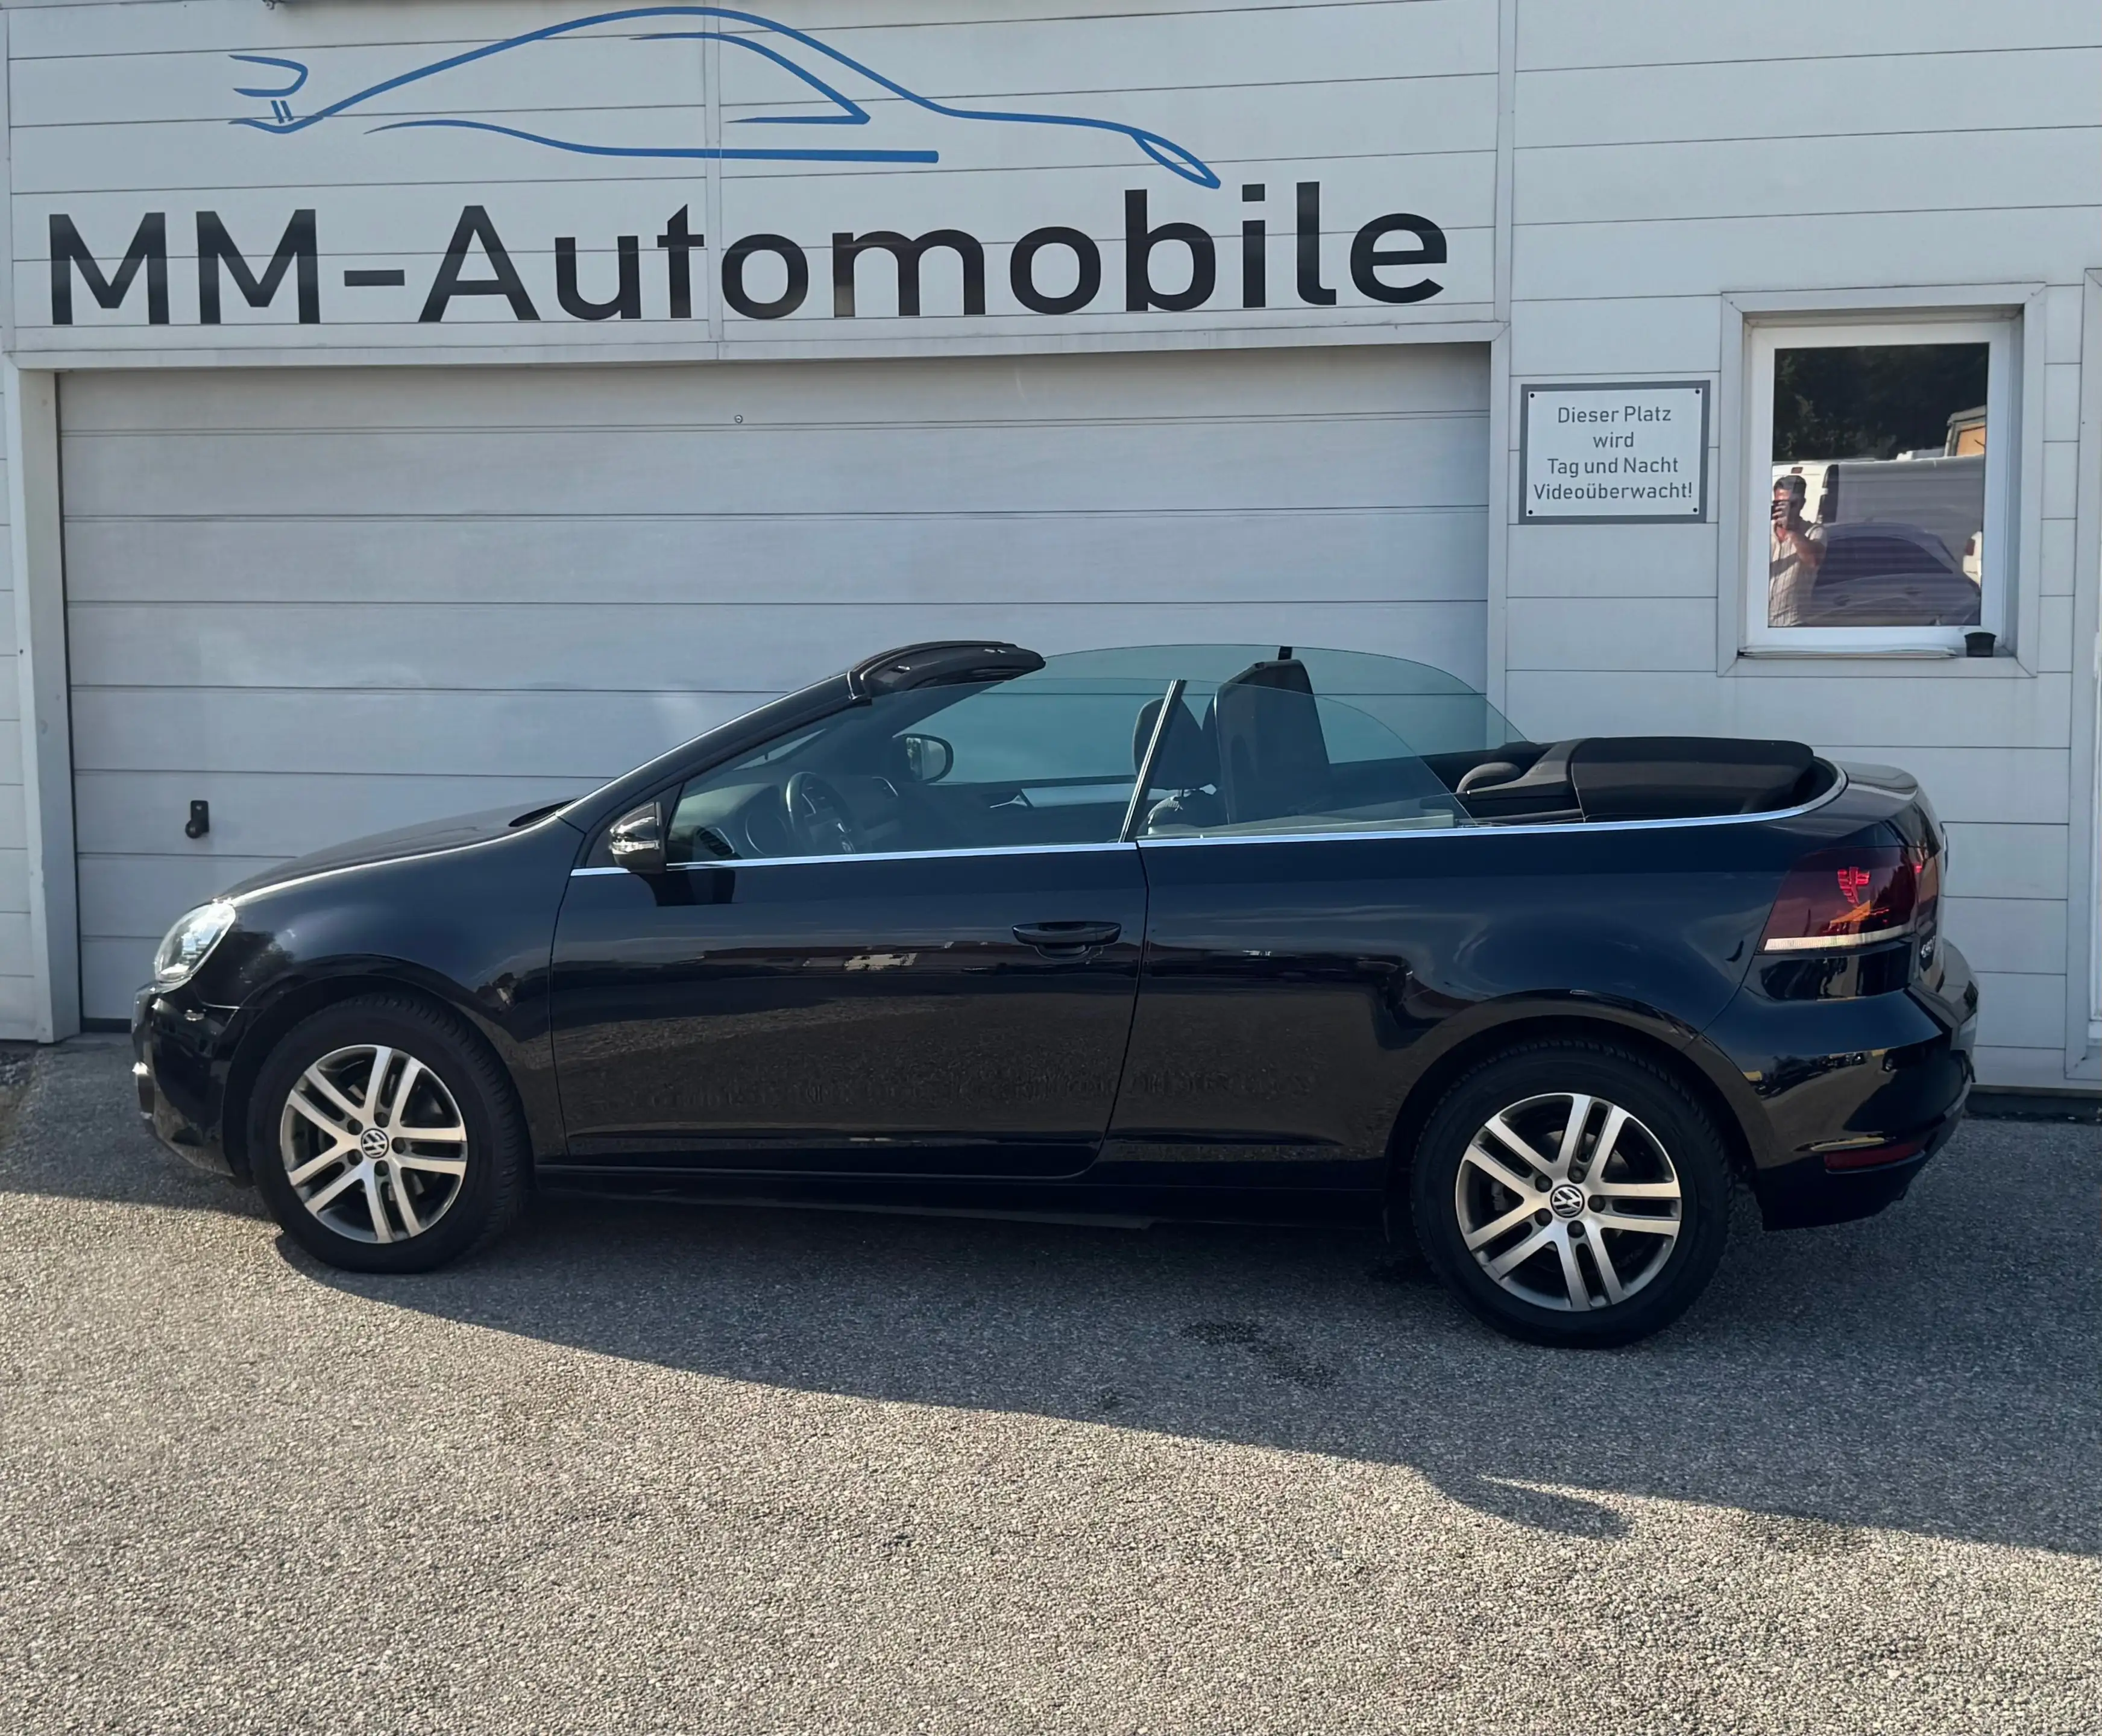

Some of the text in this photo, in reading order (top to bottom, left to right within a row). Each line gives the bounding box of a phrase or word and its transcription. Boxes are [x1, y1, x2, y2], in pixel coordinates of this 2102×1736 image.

[49, 182, 1447, 325] MM-Automobile
[1558, 406, 1671, 423] Dieser Platz
[1593, 431, 1634, 448] wird
[1547, 457, 1678, 478] Tag und Nacht
[1533, 482, 1692, 500] Videoüberwacht!
